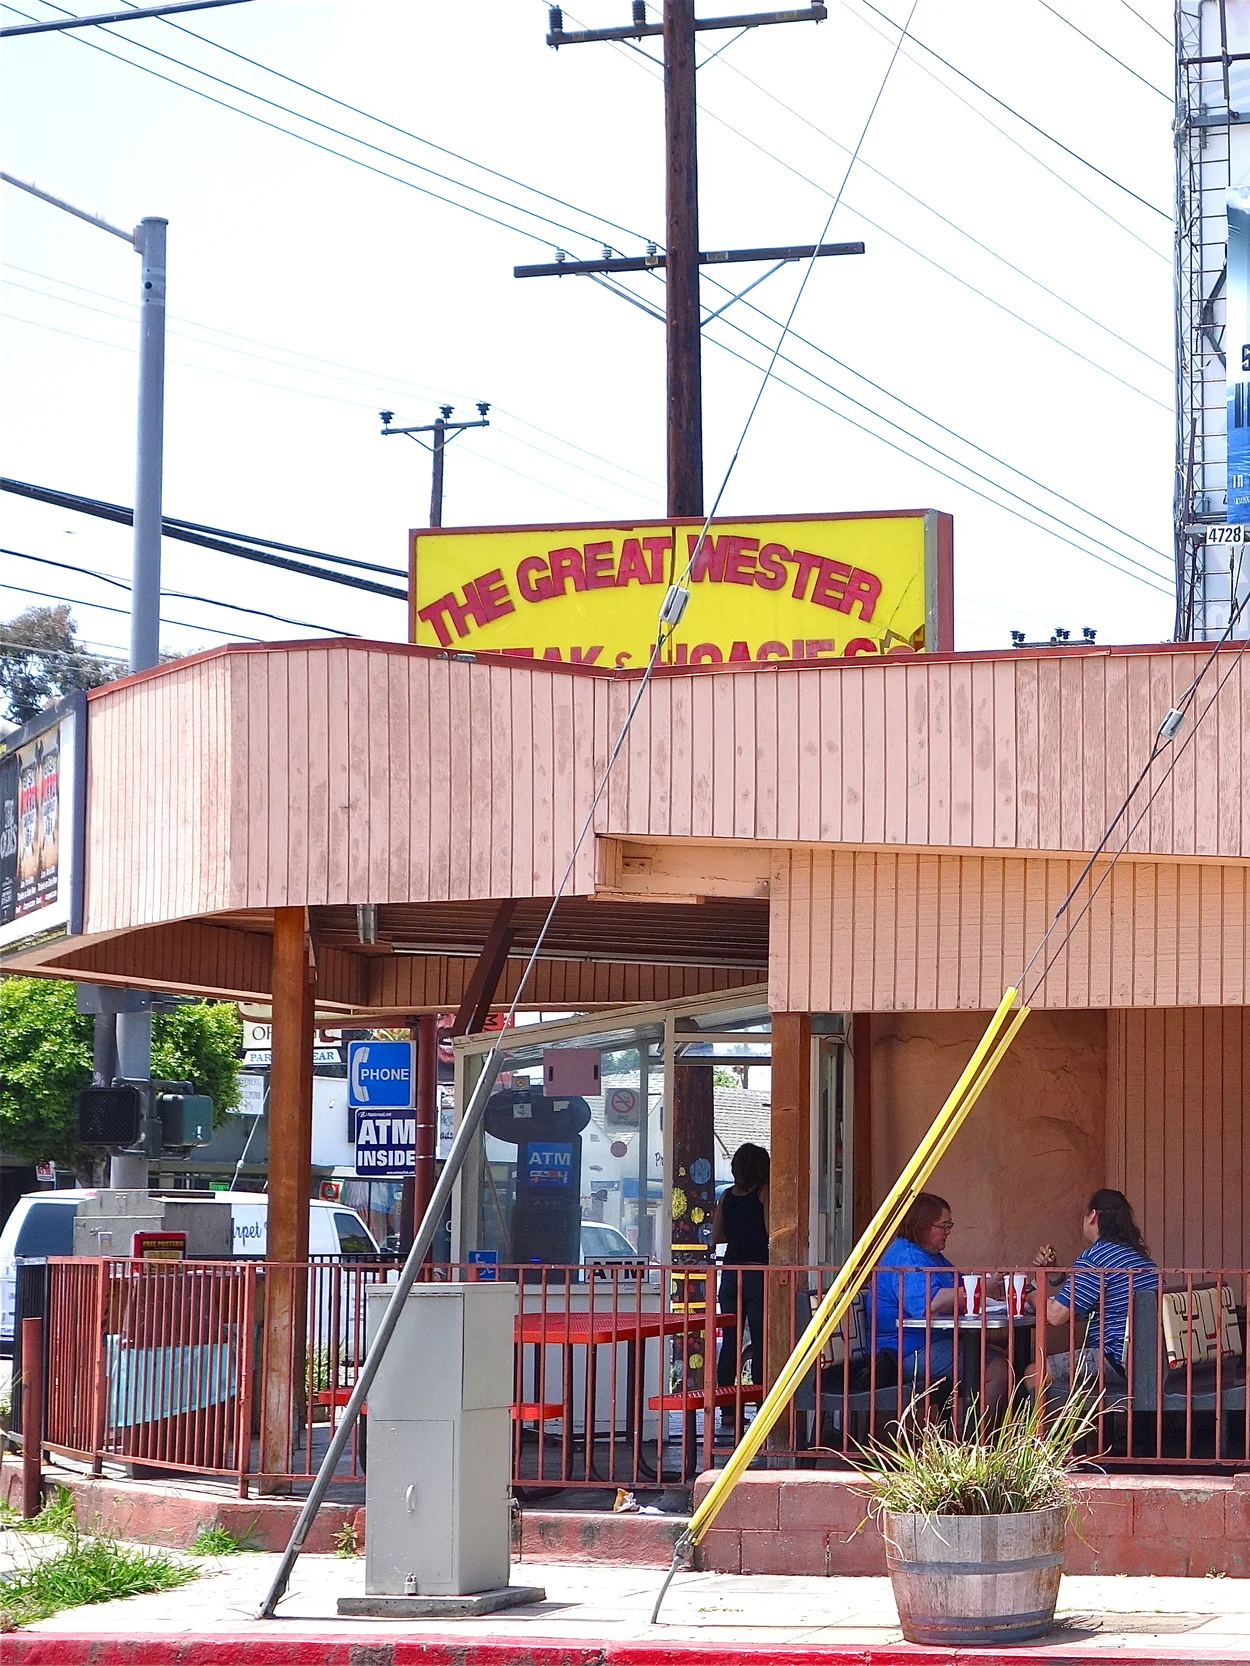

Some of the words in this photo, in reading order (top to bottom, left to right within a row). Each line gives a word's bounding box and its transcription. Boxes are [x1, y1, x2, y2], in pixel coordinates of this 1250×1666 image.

[1232, 473, 1244, 489] IN
[1208, 525, 1242, 543] 4728
[417, 567, 516, 648] THE
[515, 535, 674, 603] GREAT
[686, 534, 884, 623] WESTER
[360, 1068, 410, 1081] PHONE
[357, 1118, 416, 1145] ATM
[357, 1149, 416, 1167] INSIDE
[528, 1151, 572, 1166] ATM
